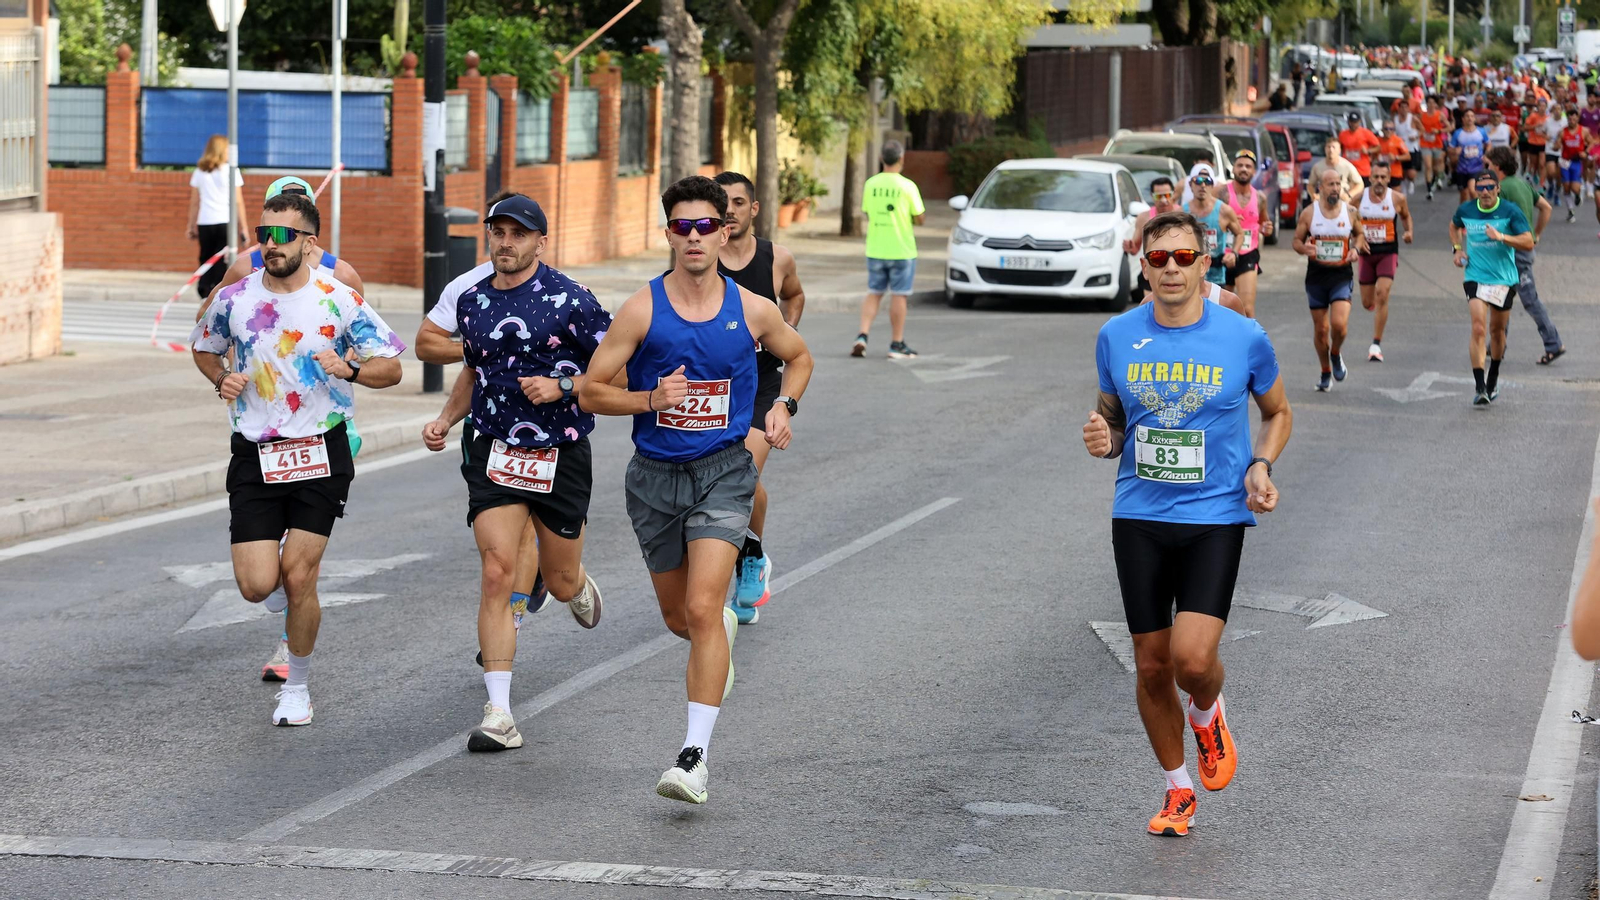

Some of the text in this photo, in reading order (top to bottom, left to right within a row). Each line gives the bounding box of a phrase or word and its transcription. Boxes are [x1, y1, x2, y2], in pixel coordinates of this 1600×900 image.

[277, 449, 311, 468] 415
[1155, 447, 1179, 466] 83
[504, 458, 539, 477] 414
